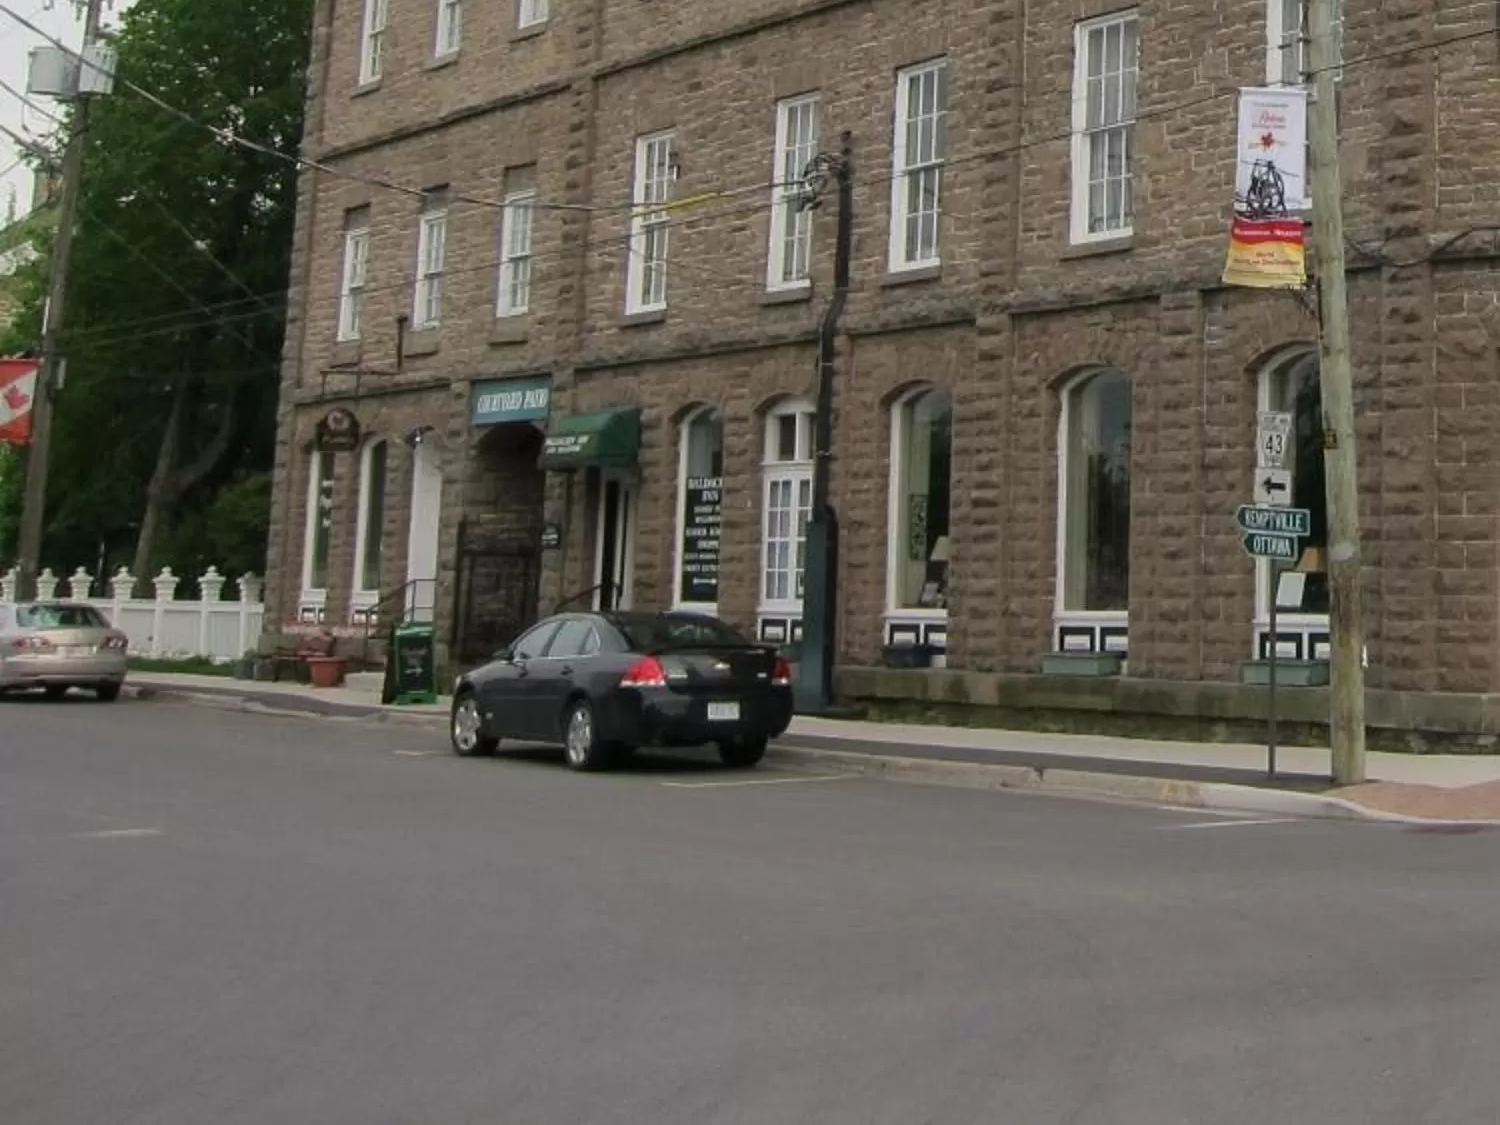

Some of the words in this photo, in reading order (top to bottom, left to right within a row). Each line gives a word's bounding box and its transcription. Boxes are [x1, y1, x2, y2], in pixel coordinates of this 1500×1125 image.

[1265, 434, 1283, 455] 43
[1245, 510, 1303, 531] KEMPTVILLE
[1253, 536, 1291, 555] OTTAWA
